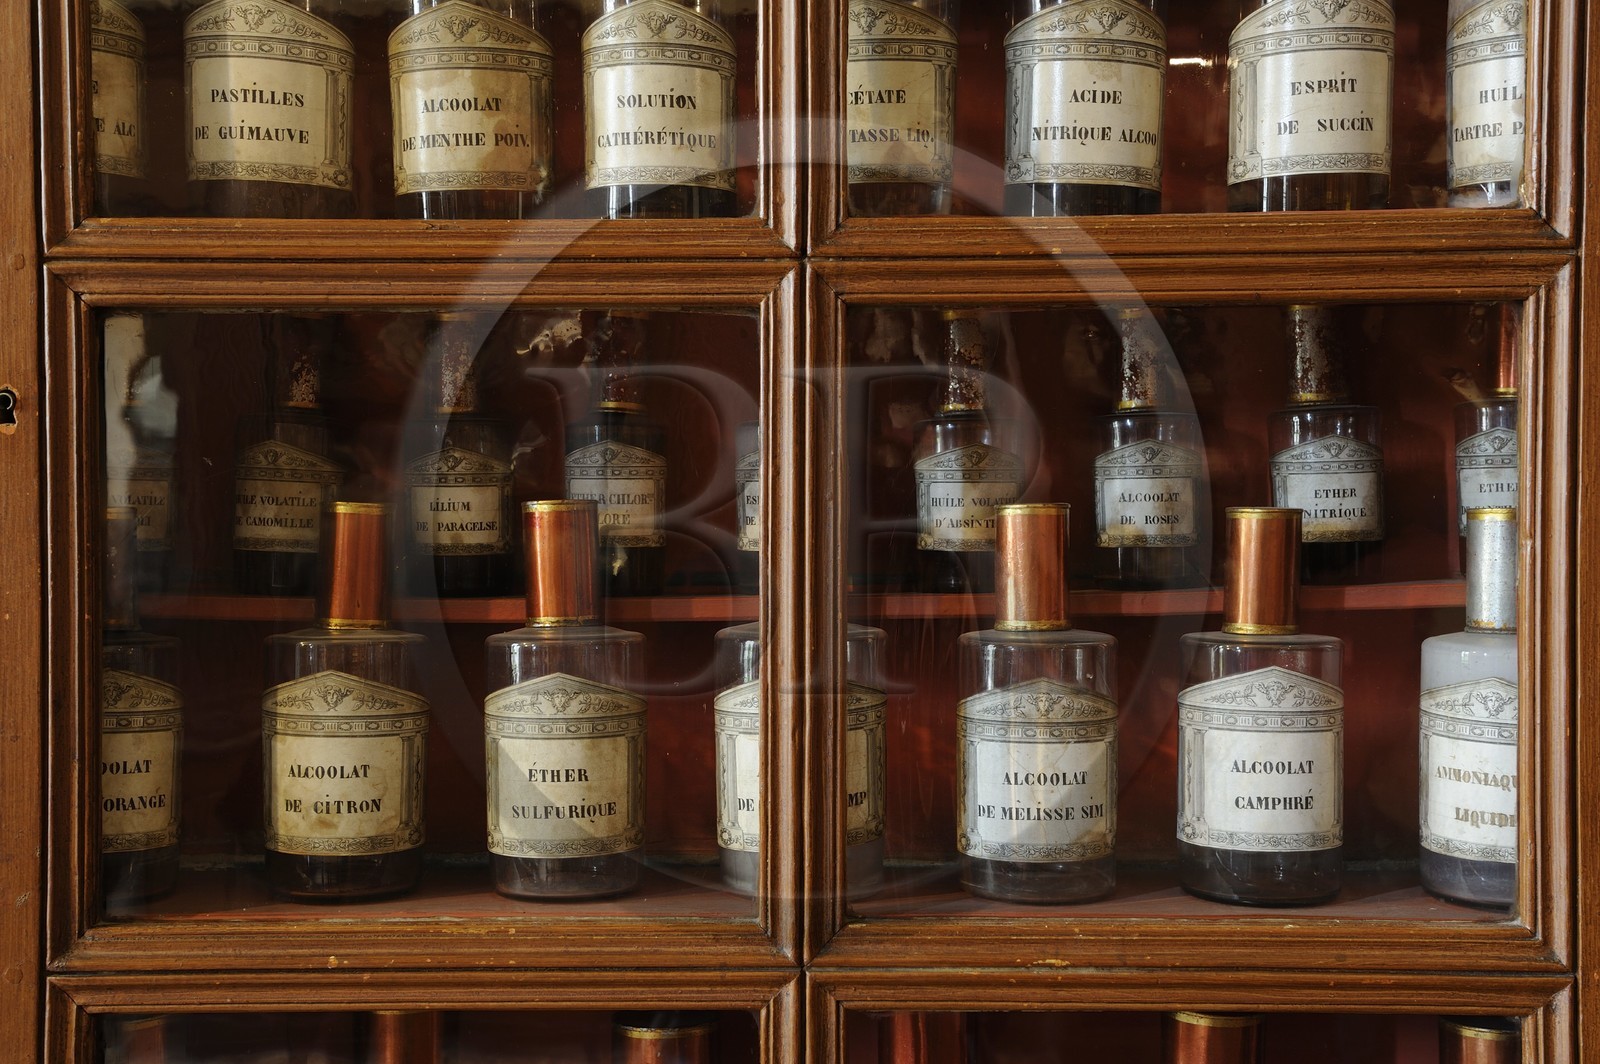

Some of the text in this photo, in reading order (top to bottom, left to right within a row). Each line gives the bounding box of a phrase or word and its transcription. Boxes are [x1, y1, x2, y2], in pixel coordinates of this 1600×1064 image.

[1069, 82, 1122, 105] ACIDE
[1291, 72, 1358, 96] ESPRIT
[1479, 80, 1522, 104] HUIL
[211, 82, 304, 108] PASTILLES
[617, 88, 697, 110] SOLUTION
[422, 98, 502, 113] ALCOOLAT
[113, 121, 136, 137] ALC
[195, 119, 310, 144] DE GUIMAUVE
[1032, 120, 1158, 146] NITRIQUE ALCOO
[1277, 110, 1374, 136] DE SUCCIN
[1454, 122, 1502, 142] TARTRE
[402, 124, 530, 152] DE MENTHE POIV.
[597, 126, 716, 153] CATHÉRÉTIQUE
[849, 122, 934, 148] TASSE LIQ.
[260, 491, 317, 508] VOLATILE
[931, 494, 964, 507] HUILE
[1118, 492, 1180, 503] ALCOOLAT
[1314, 488, 1357, 499] ETHER
[430, 498, 471, 512] LILIUM
[1303, 502, 1367, 520] NITRIQUE
[246, 513, 314, 528] CAMOMILLE
[416, 521, 498, 532] DE PARACELSE
[746, 516, 756, 526] DE
[1120, 514, 1180, 526] DE ROSES
[288, 764, 370, 780] ALCOOLAT
[528, 762, 589, 782] ÉTHER
[1230, 760, 1314, 775] ALCOOLAT
[1002, 771, 1088, 786] ALCOOLAT
[285, 794, 382, 814] DE CITRON
[738, 798, 754, 812] DE
[978, 804, 996, 818] DE
[1082, 796, 1104, 819] SIM
[1234, 788, 1314, 810] CAMPHRÉ
[512, 798, 617, 823] SULFURIQUE
